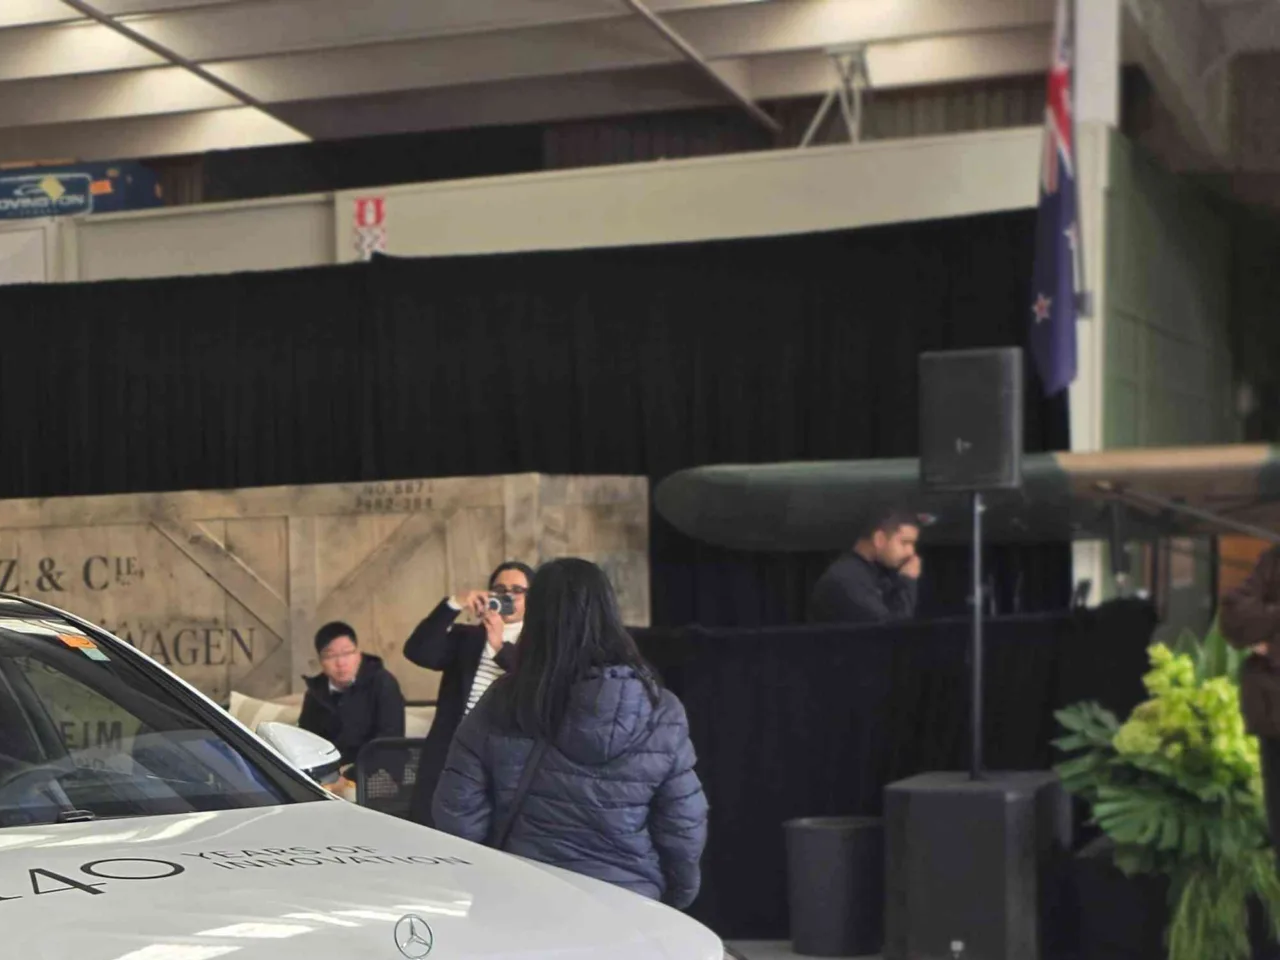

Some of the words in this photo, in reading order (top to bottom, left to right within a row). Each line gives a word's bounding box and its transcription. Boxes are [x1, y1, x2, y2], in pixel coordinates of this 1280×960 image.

[36, 556, 65, 592] &
[181, 846, 321, 860] YEARS
[325, 845, 378, 854] OF
[212, 855, 473, 870] INNOVATION
